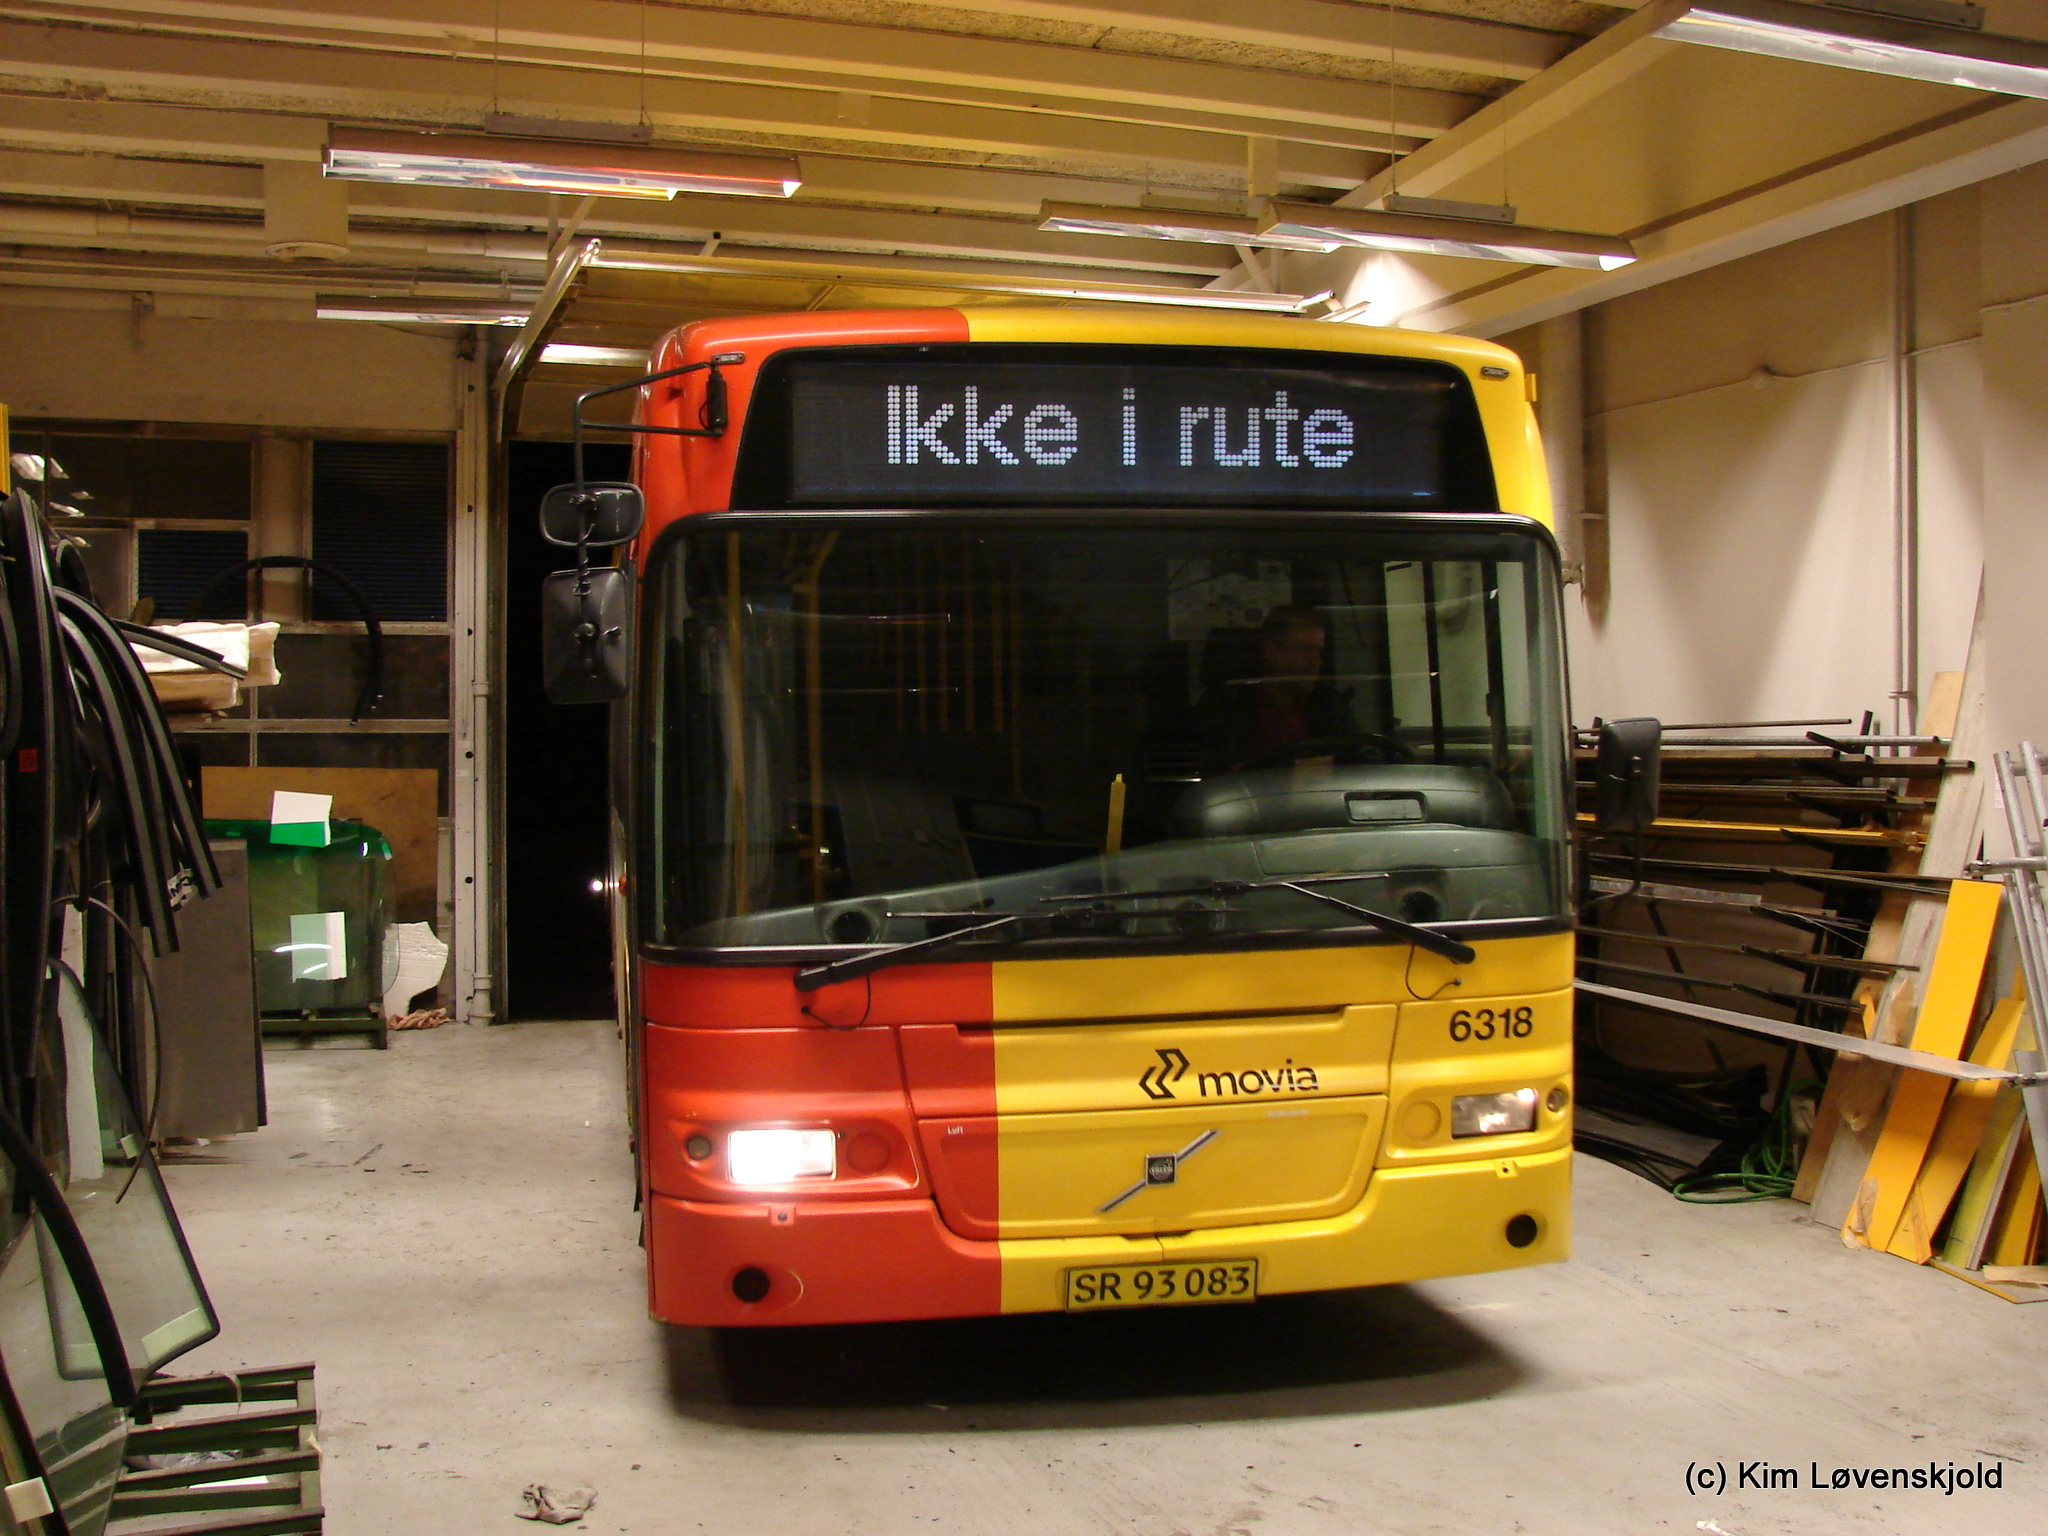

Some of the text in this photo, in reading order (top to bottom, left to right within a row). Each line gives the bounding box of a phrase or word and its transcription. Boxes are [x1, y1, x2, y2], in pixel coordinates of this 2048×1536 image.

[887, 384, 1354, 468] Ikke i rute
[1449, 1006, 1533, 1042] 6318
[1198, 1058, 1319, 1097] movia
[1074, 1266, 1250, 1303] SR 93 083
